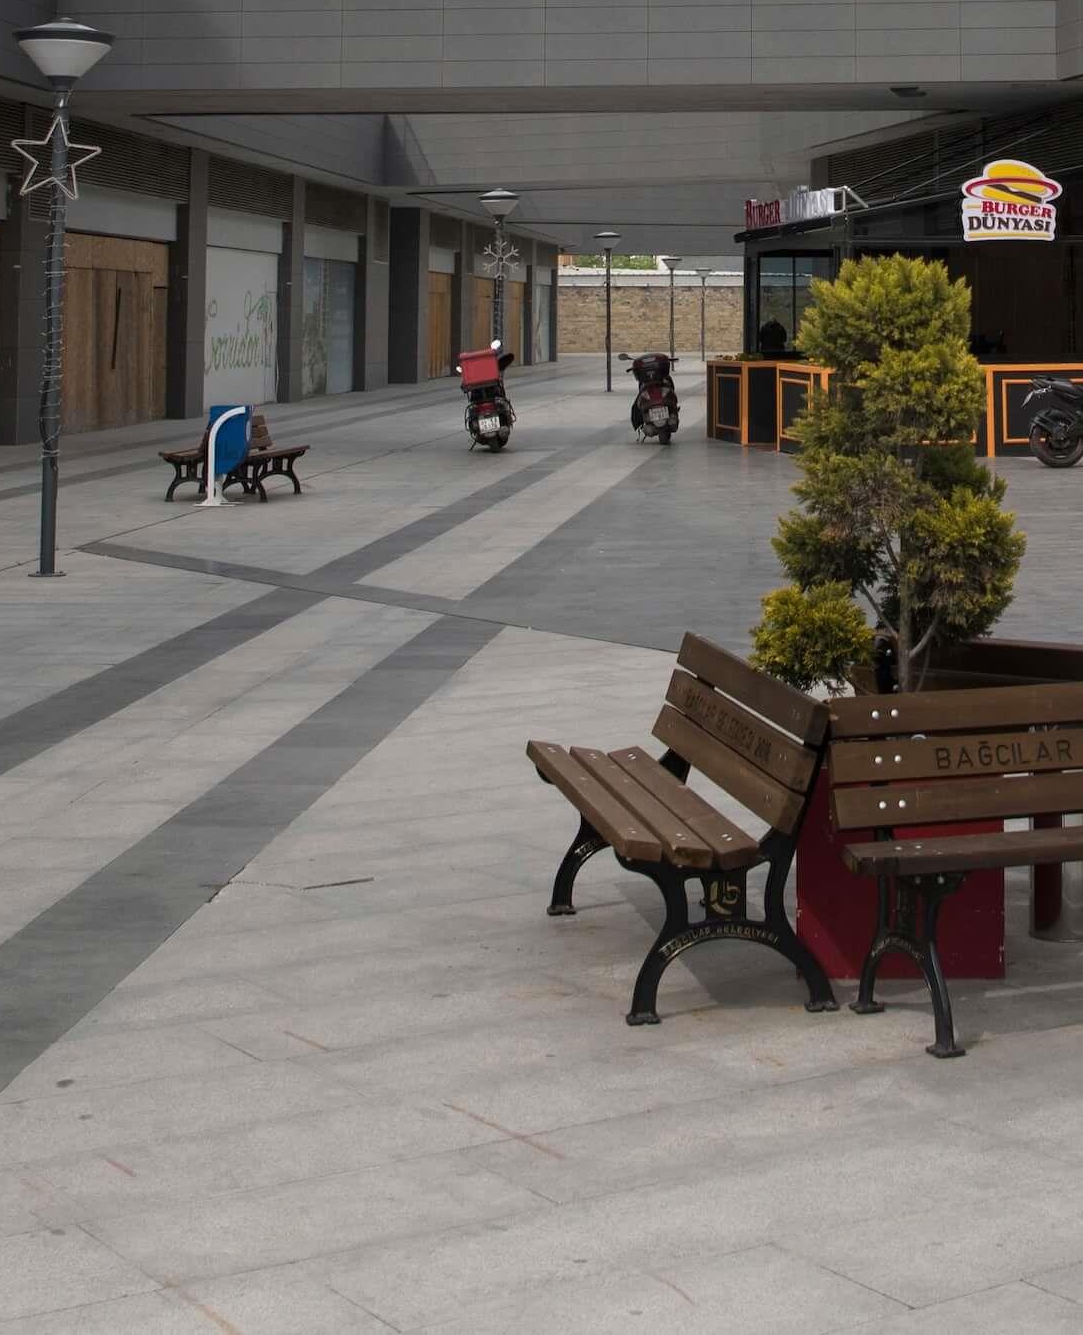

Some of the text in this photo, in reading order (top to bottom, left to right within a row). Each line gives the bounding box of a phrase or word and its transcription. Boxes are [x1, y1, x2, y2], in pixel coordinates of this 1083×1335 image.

[745, 198, 782, 228] BURGER
[981, 200, 1052, 219] BURGER
[967, 213, 1052, 233] DÜNYASI
[934, 739, 1074, 770] BAĞCILAR
